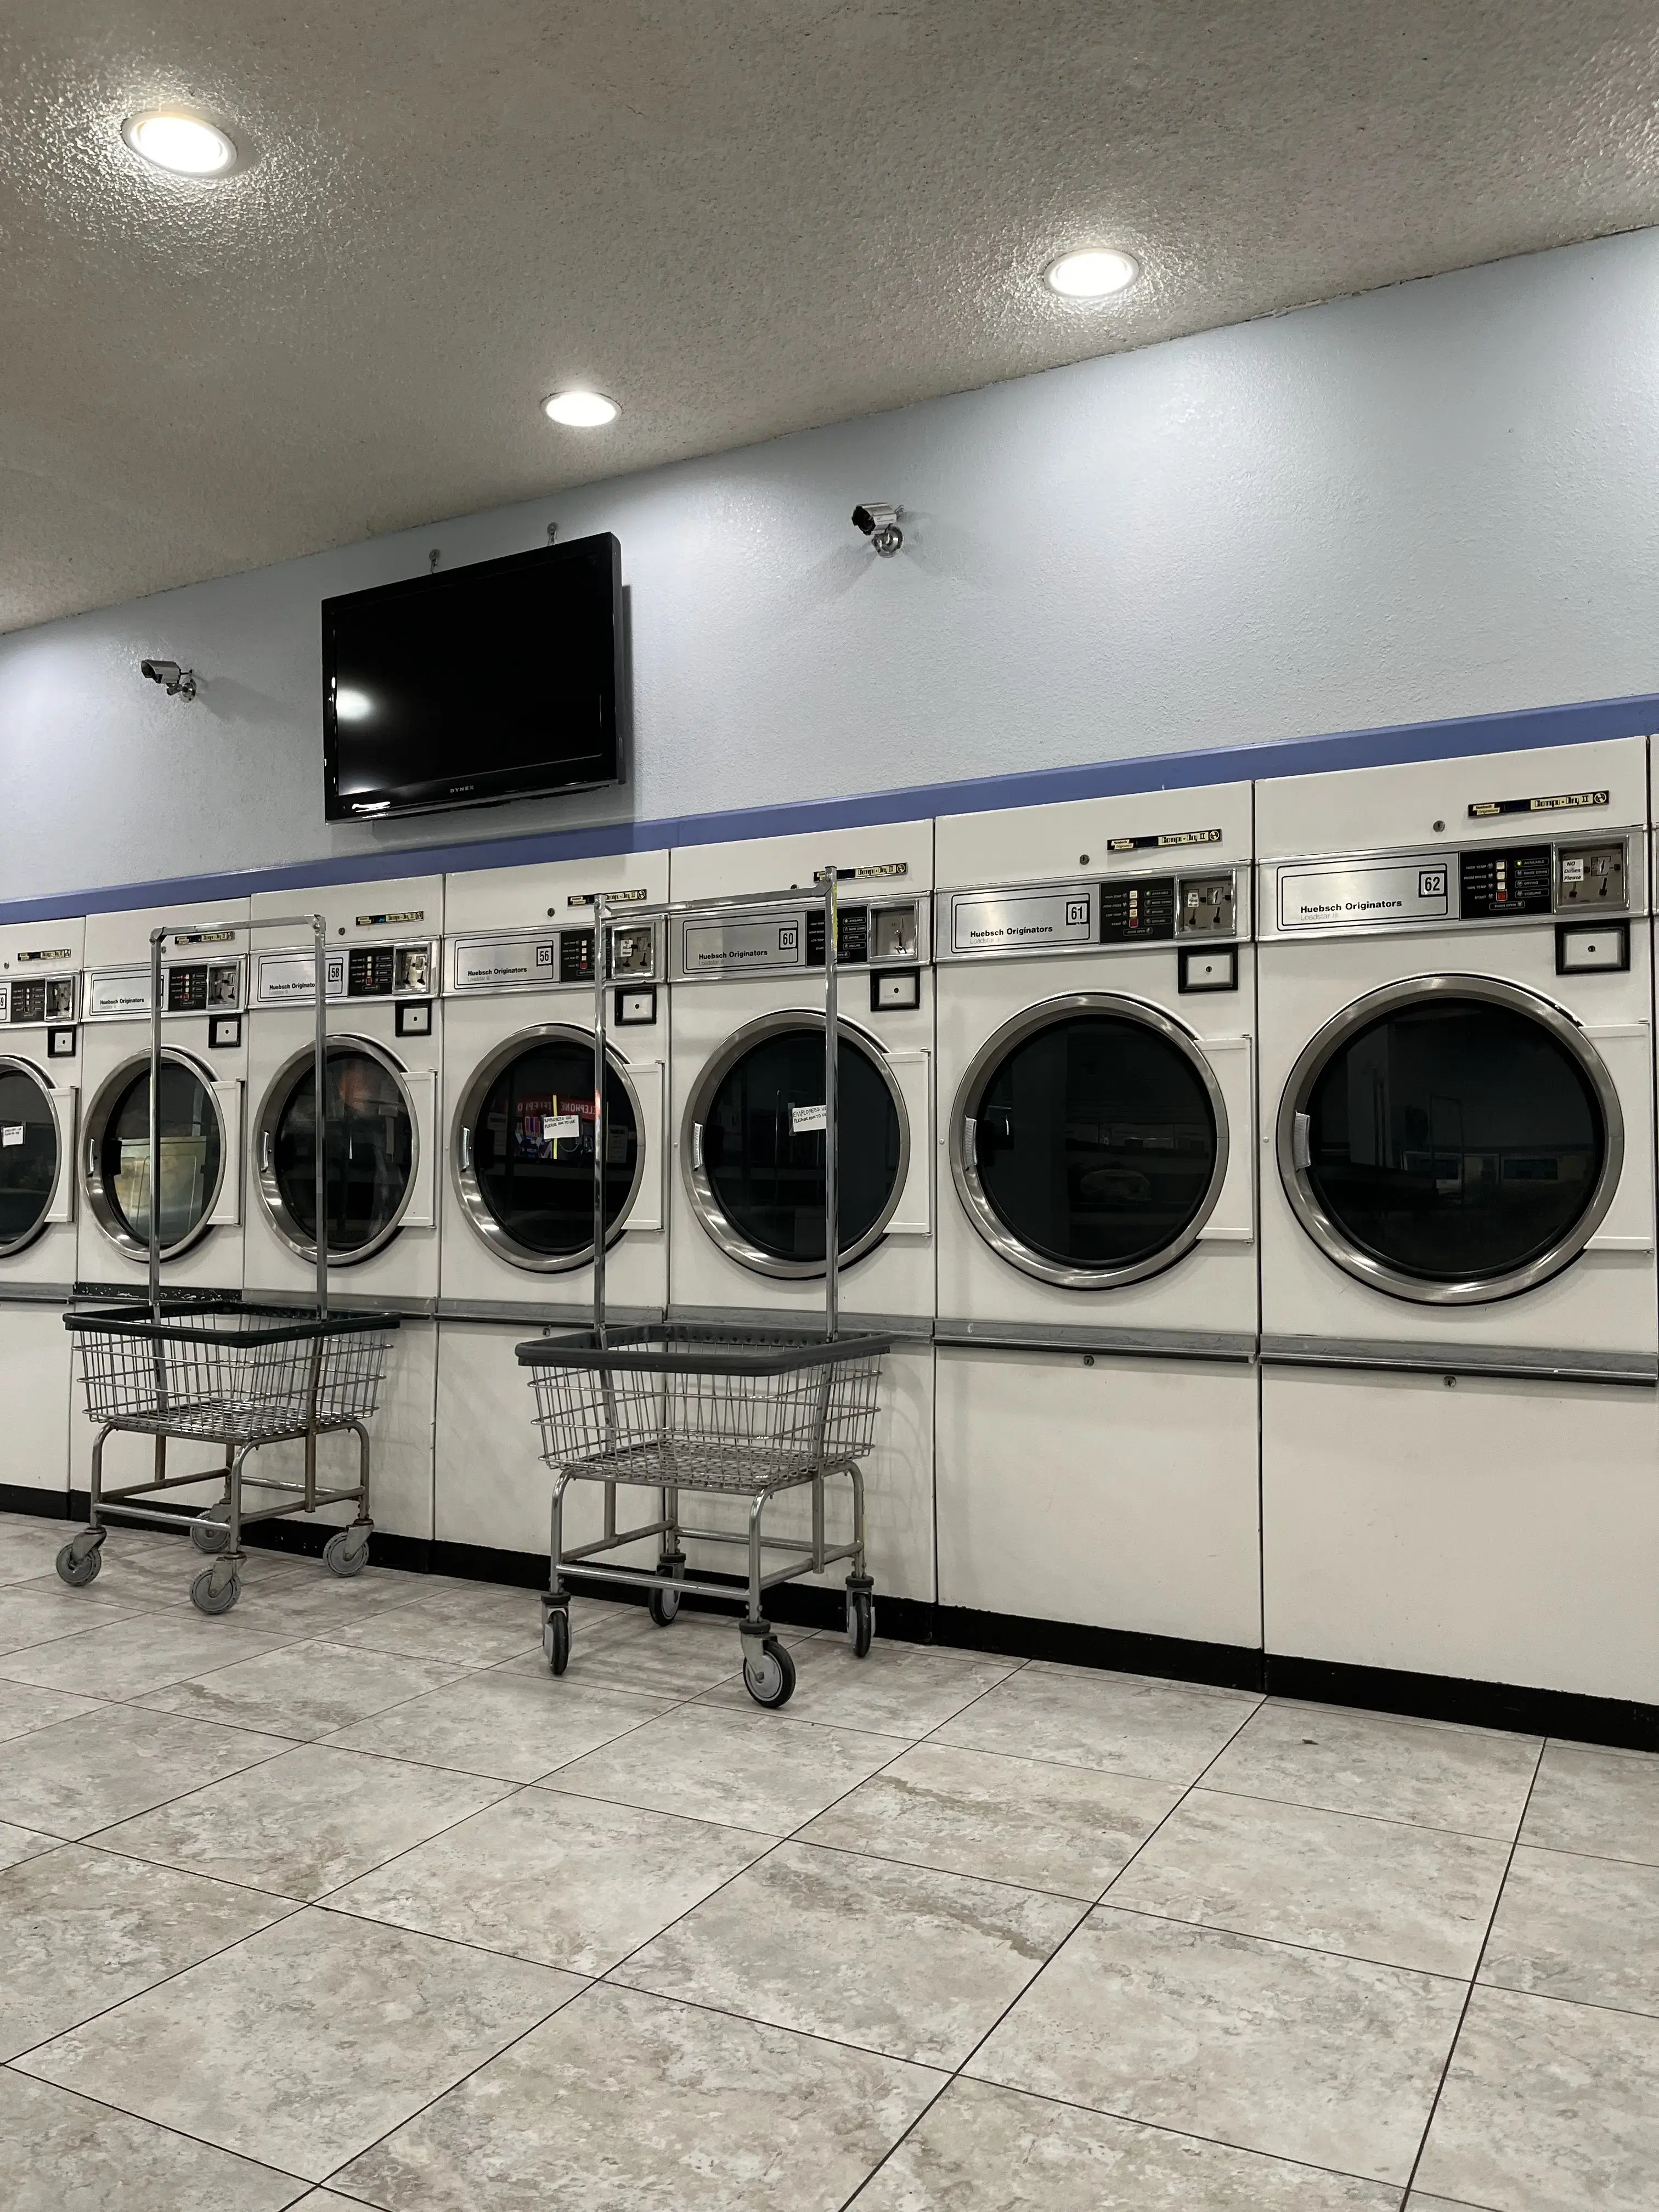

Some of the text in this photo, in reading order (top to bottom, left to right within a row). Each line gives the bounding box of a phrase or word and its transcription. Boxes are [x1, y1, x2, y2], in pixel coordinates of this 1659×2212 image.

[1425, 876, 1440, 891] 62
[1300, 900, 1402, 913] Huebsch Originators
[1071, 906, 1082, 919] 61
[1300, 913, 1330, 921] Loadstar
[970, 926, 1053, 938] Huebsch Originators
[783, 933, 793, 945] 60
[540, 951, 549, 962] 56
[729, 950, 768, 958] Originators
[331, 968, 339, 978] 58
[793, 1107, 820, 1118] EMPLOYEES
